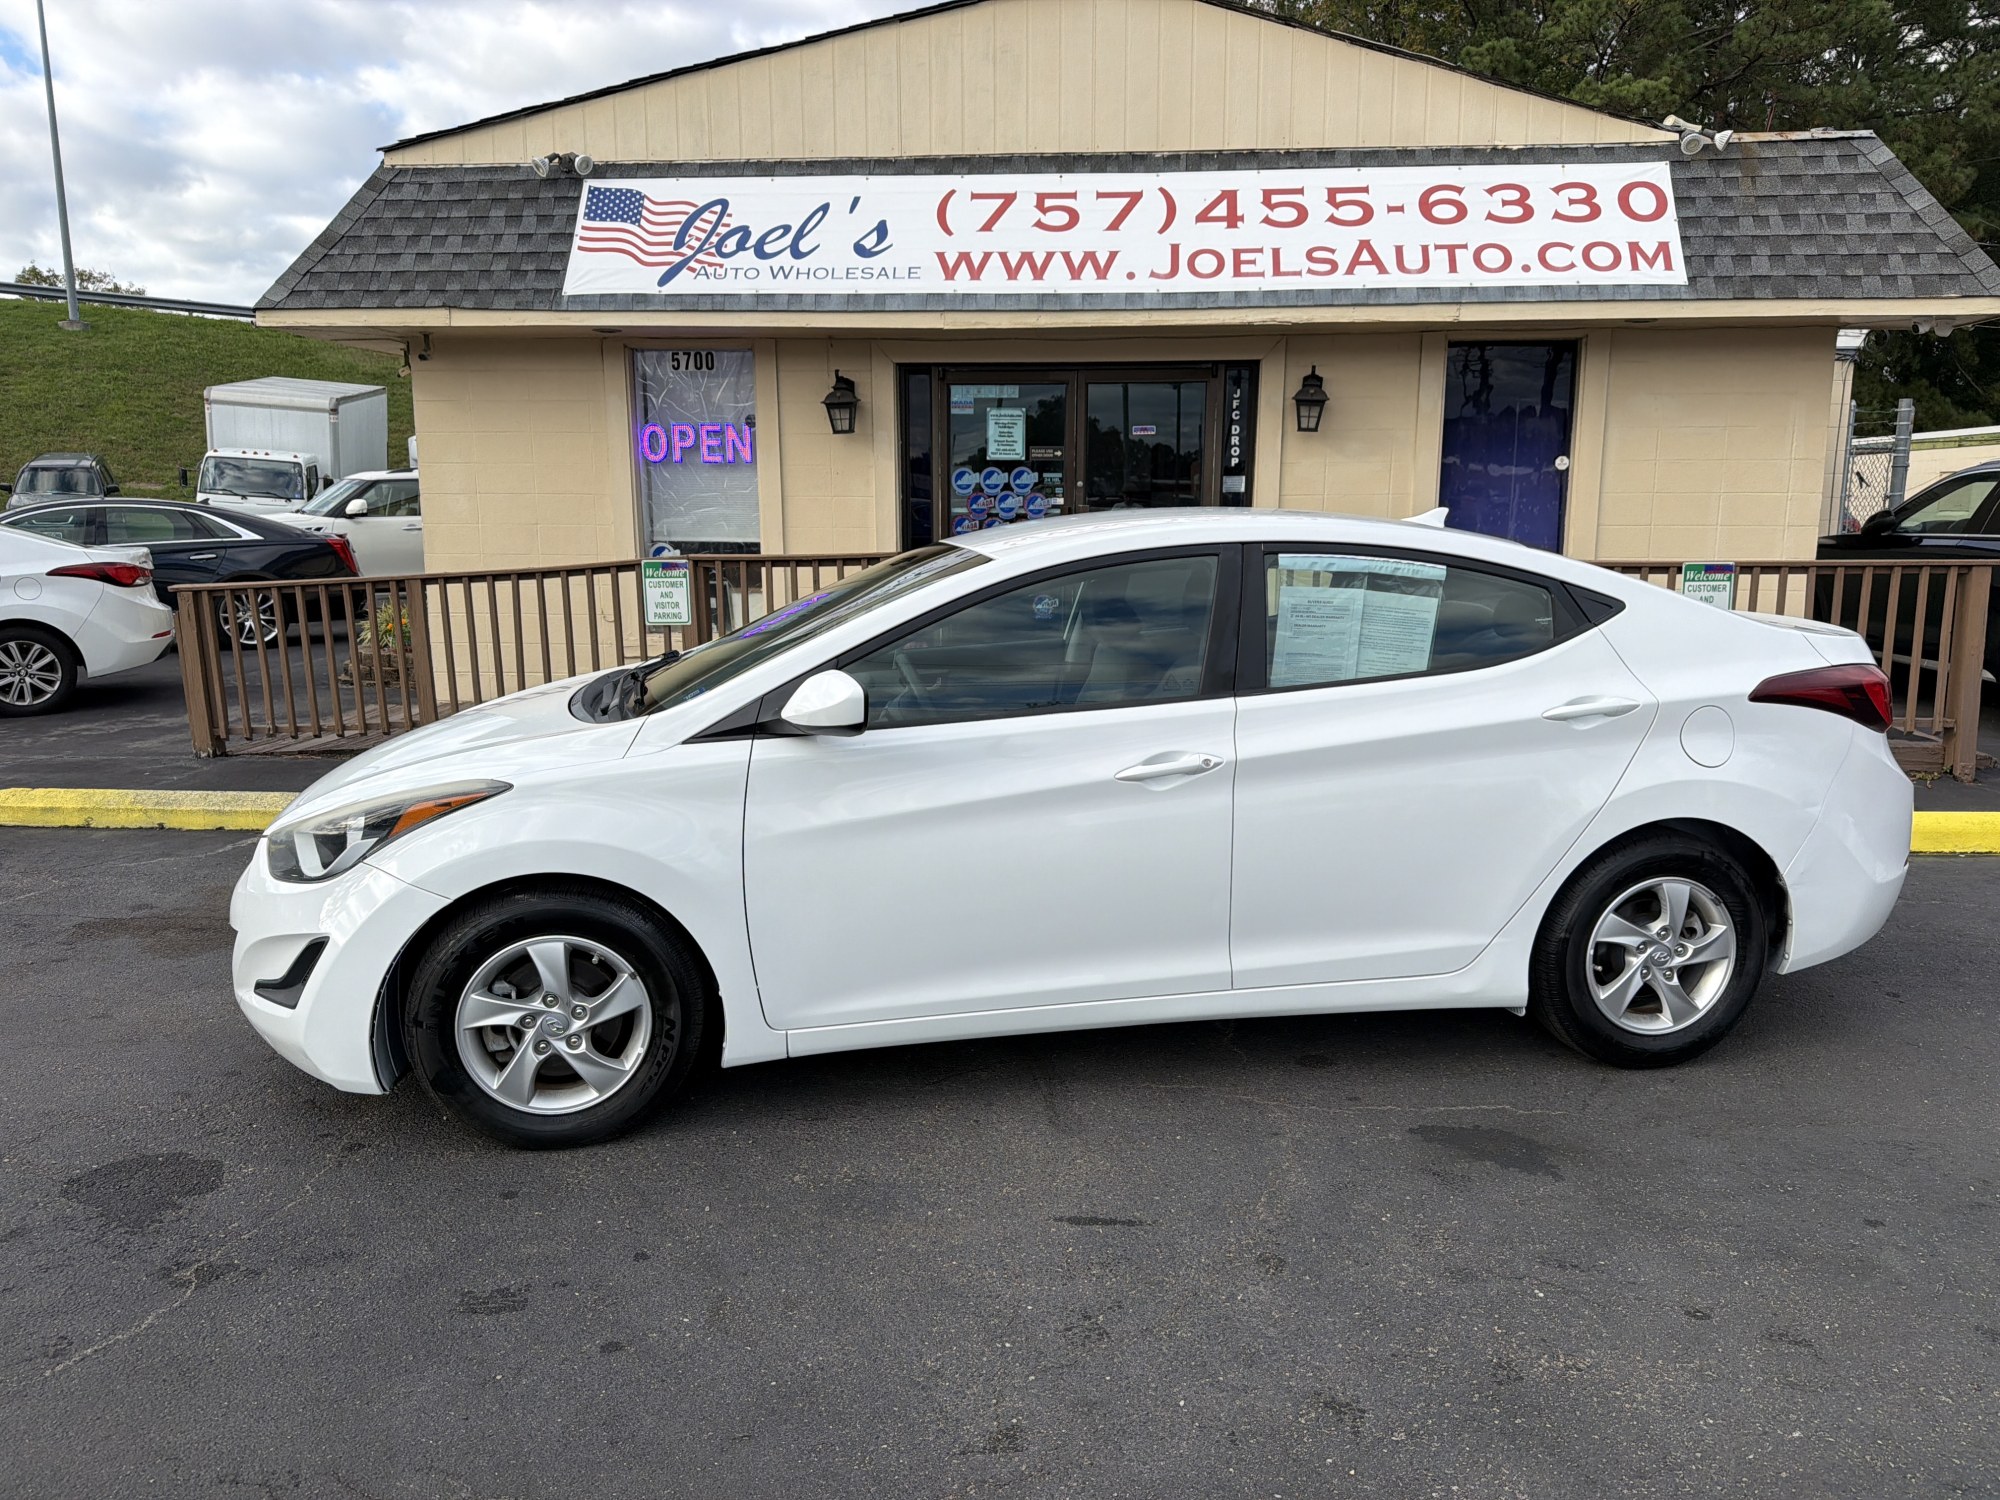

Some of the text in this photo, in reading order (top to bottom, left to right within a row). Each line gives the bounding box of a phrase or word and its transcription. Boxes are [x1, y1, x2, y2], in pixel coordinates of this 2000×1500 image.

[936, 180, 1669, 237] (757)455-6330
[657, 197, 893, 288] Joel's
[693, 264, 922, 281] AUTO WHOLESALE
[671, 351, 715, 371] 5700
[641, 422, 753, 464] OPEN
[645, 568, 686, 578] Welcome
[1685, 570, 1730, 580] Welcome
[648, 580, 684, 588] CUSTOMER
[1687, 584, 1727, 592] CUSTOMER
[660, 591, 673, 599] AND
[1699, 595, 1714, 603] AND
[654, 601, 680, 609] VISITOR
[653, 611, 682, 620] PARKING
